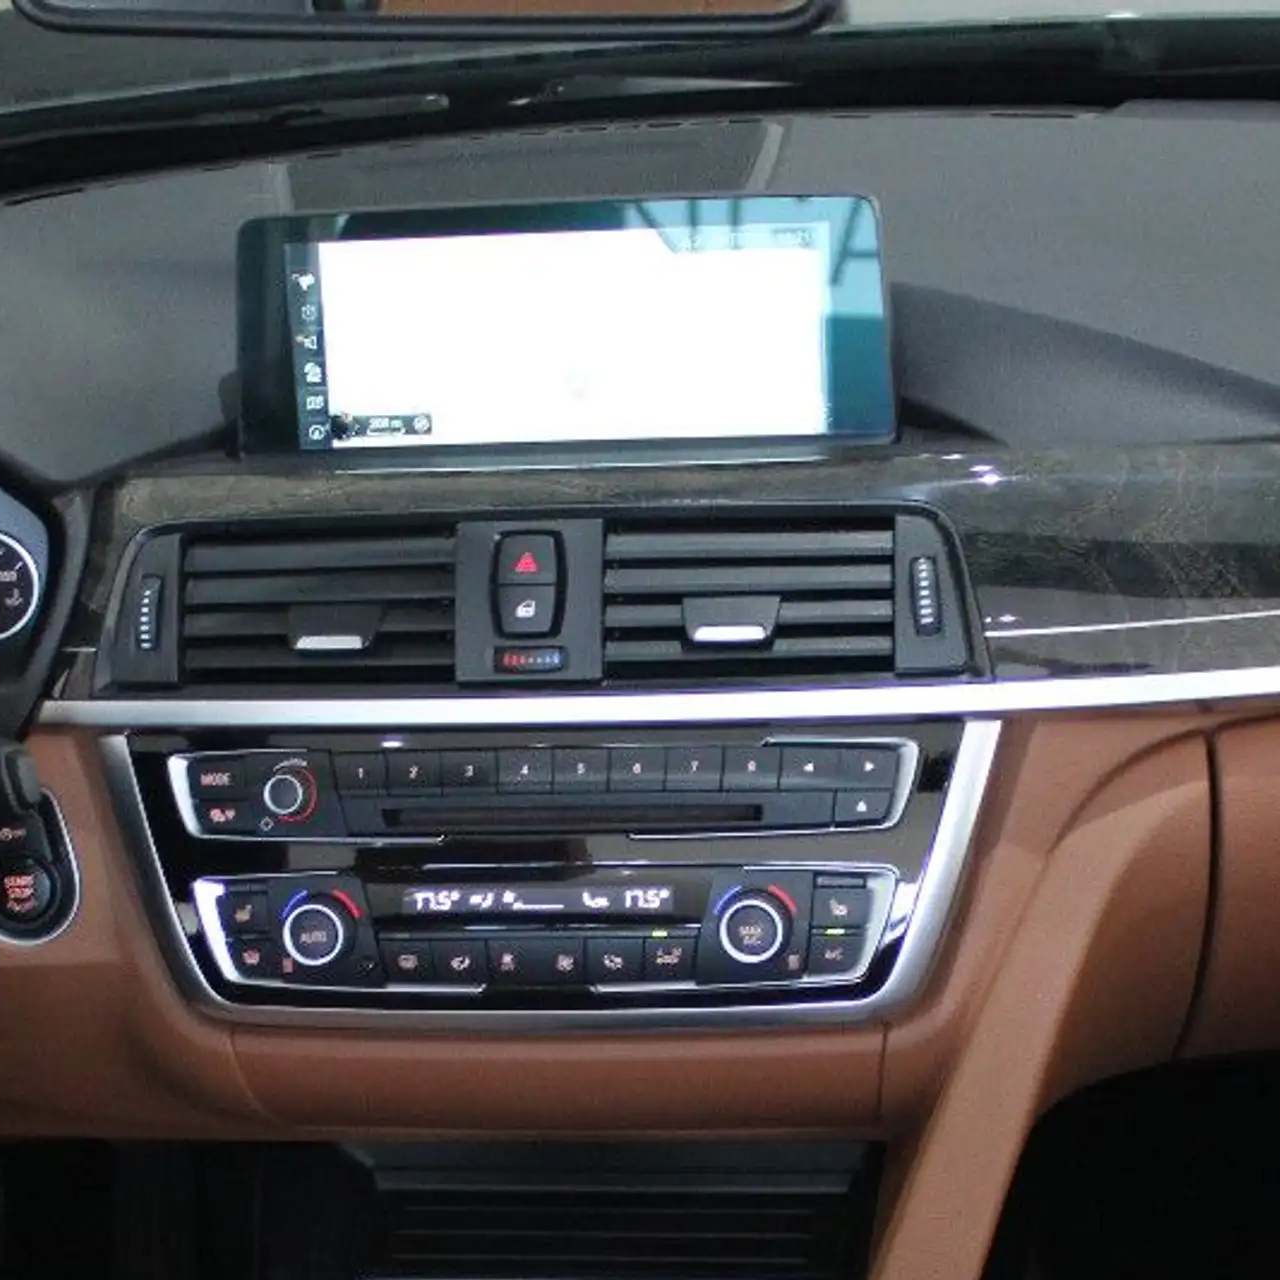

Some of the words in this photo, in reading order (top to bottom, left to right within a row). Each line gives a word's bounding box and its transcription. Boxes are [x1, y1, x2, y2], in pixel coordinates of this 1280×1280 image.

[358, 767, 364, 779] 1
[409, 765, 418, 779] 2
[464, 765, 473, 777] 3
[520, 765, 529, 775] 4
[632, 763, 641, 774] 6
[299, 931, 327, 945] AUTO
